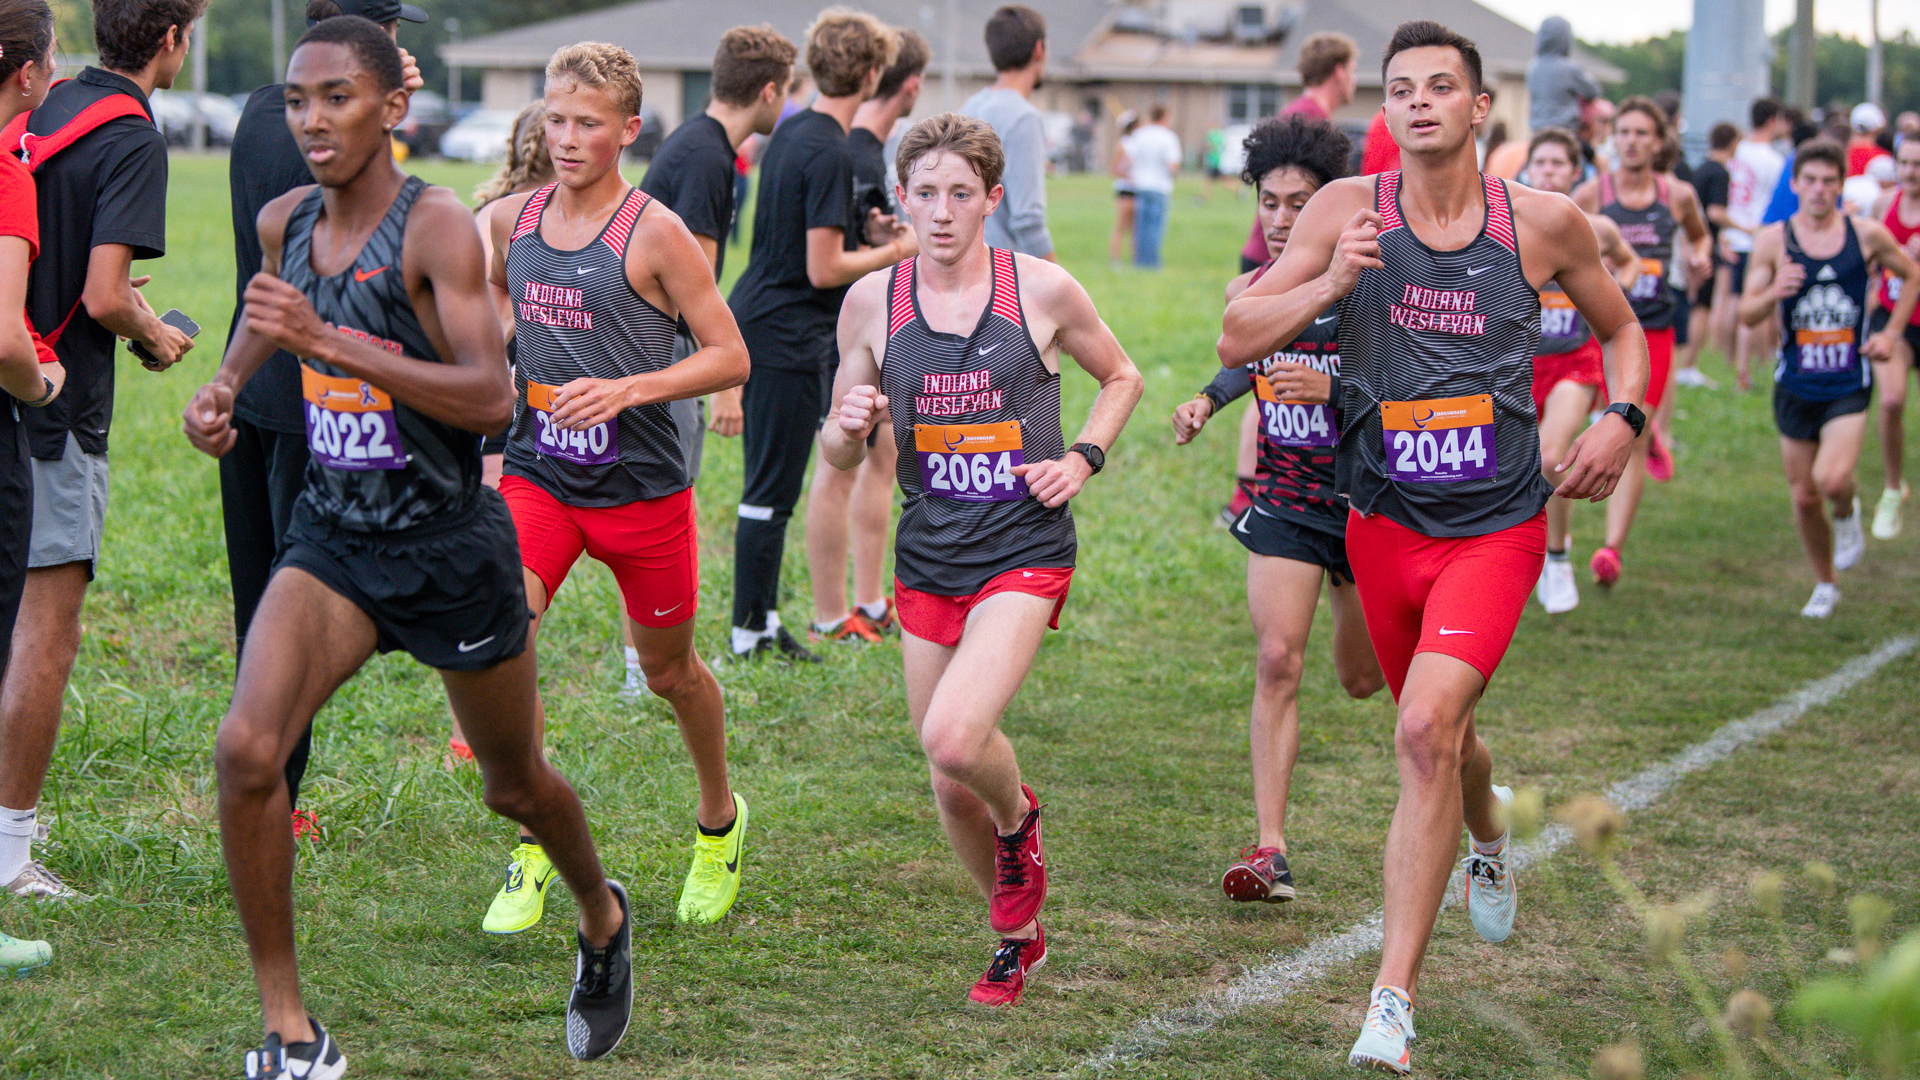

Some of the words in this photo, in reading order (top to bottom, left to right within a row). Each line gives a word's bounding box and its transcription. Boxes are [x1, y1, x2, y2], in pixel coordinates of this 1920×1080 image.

[524, 281, 583, 308] INDIANA
[1402, 284, 1476, 311] INDIANA
[518, 302, 594, 330] WESLEYAN
[1389, 304, 1488, 335] WESLEYAN
[1801, 342, 1850, 369] 2117
[923, 369, 990, 394] INDIANA
[914, 389, 1003, 416] WESLEYAN
[309, 403, 395, 459] 2022
[536, 409, 609, 455] 2040
[1264, 401, 1330, 439] 2004
[1393, 426, 1487, 473] 2044
[927, 451, 1016, 493] 2064
